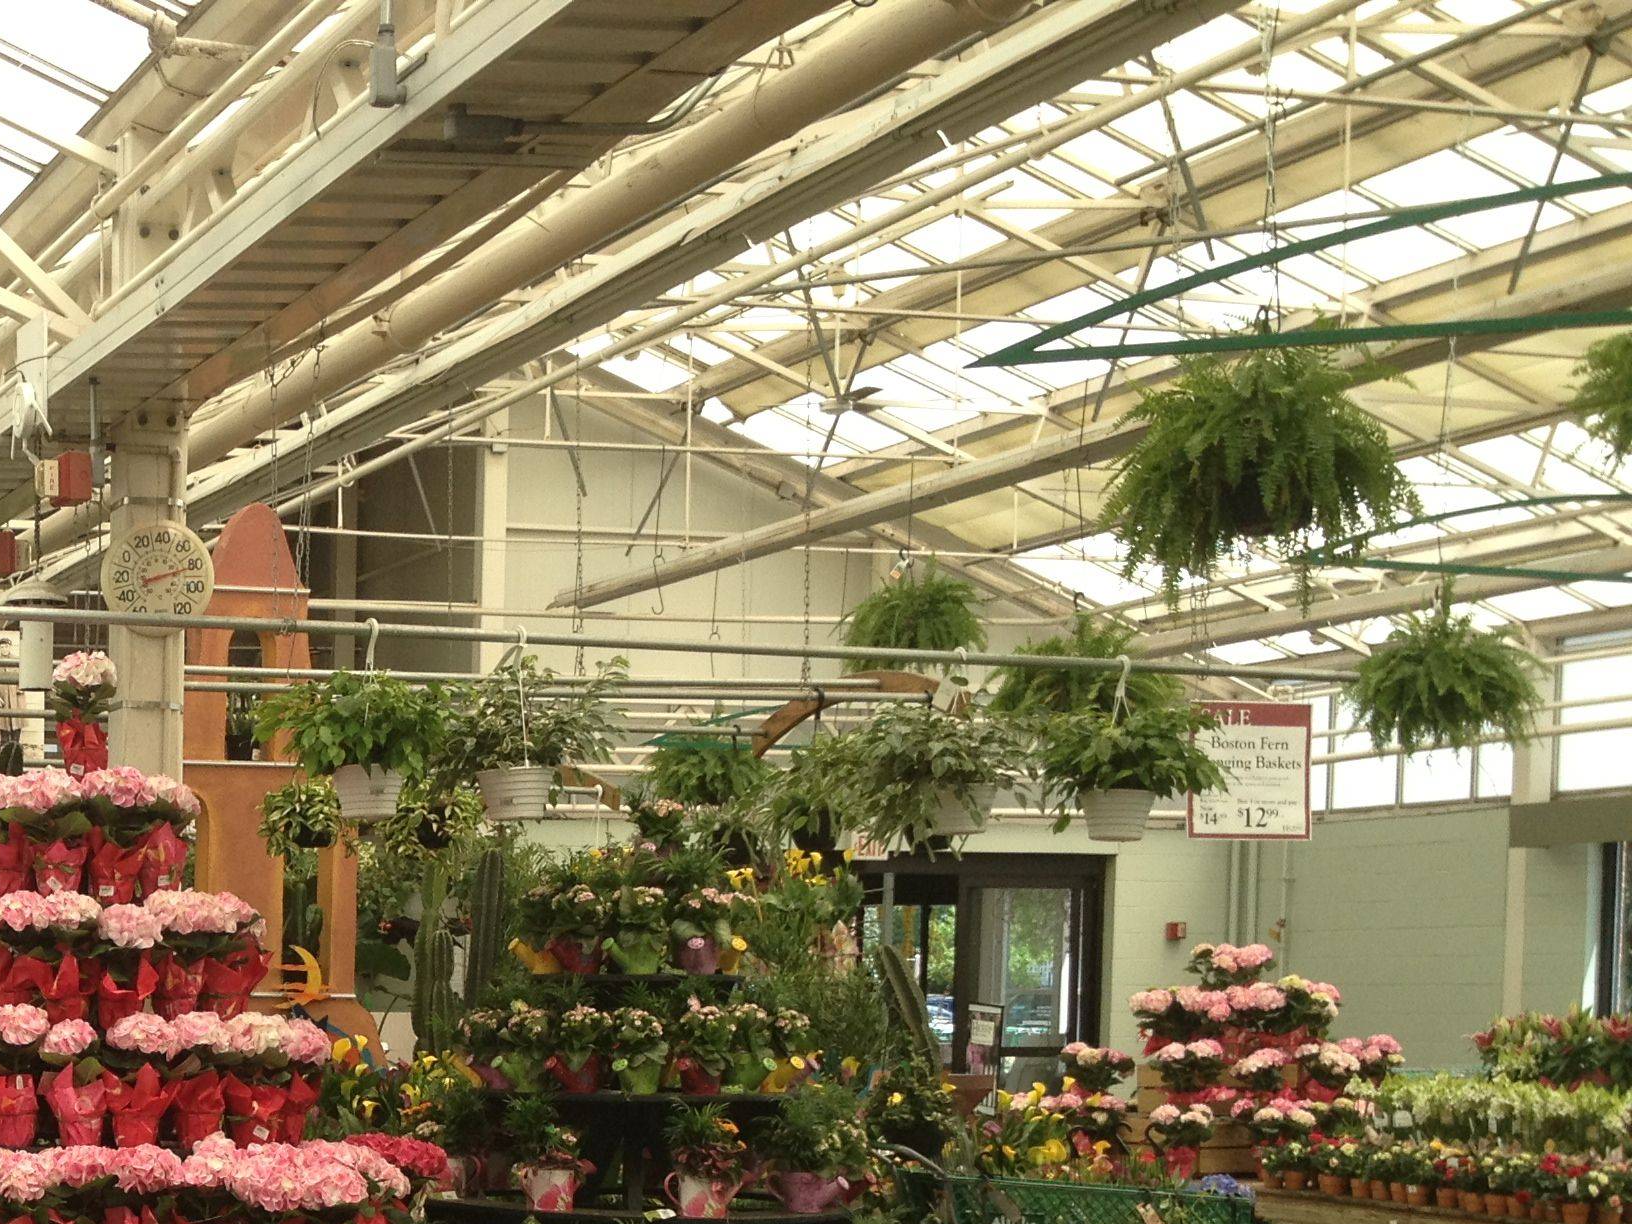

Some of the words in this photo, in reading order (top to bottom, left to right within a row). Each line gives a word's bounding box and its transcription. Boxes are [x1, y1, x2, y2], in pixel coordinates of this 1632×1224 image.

[134, 535, 150, 549] 20
[154, 530, 171, 544] 40
[175, 539, 192, 553] 60
[122, 550, 131, 563] 0
[187, 558, 203, 570] 80
[185, 580, 205, 593] 100
[173, 602, 192, 615] 120
[1211, 735, 1256, 751] Boston
[1260, 736, 1290, 751] Fern
[1256, 756, 1302, 770] Baskets
